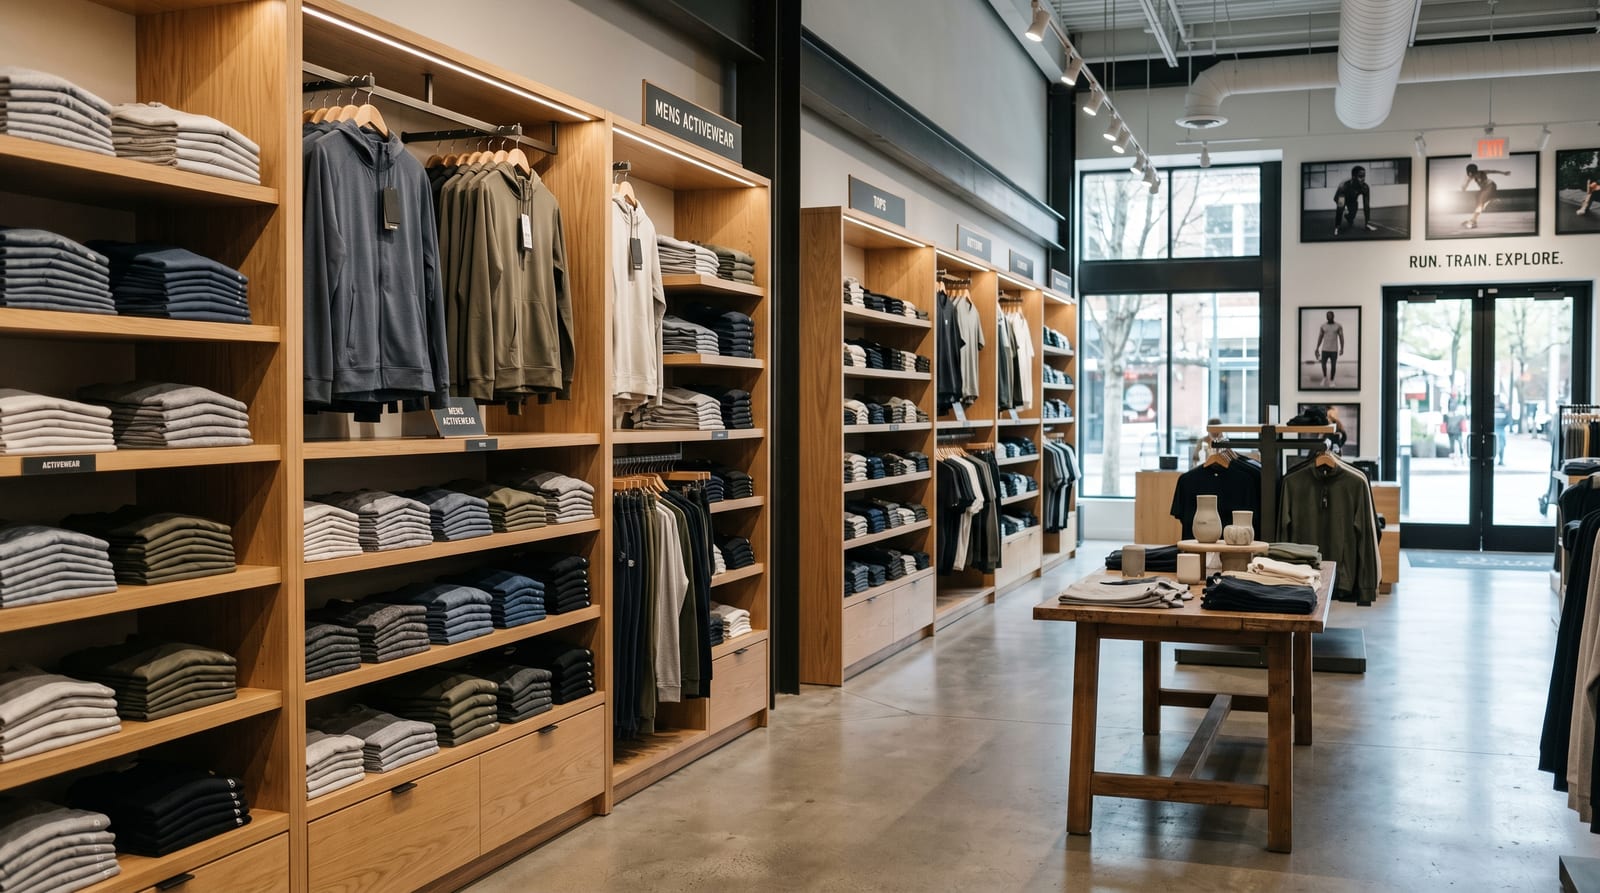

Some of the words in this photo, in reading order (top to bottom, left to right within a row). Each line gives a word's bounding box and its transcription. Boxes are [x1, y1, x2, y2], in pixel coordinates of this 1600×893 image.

[655, 99, 680, 125] MENS
[683, 112, 734, 149] ACTIVEWEAR
[1409, 255, 1442, 268] RUN.
[1446, 253, 1492, 267] TRAIN.
[1496, 251, 1564, 266] EXPLORE.
[442, 417, 476, 425] ACTIVEWEAR
[42, 460, 80, 469] ACTIVEWEAR
